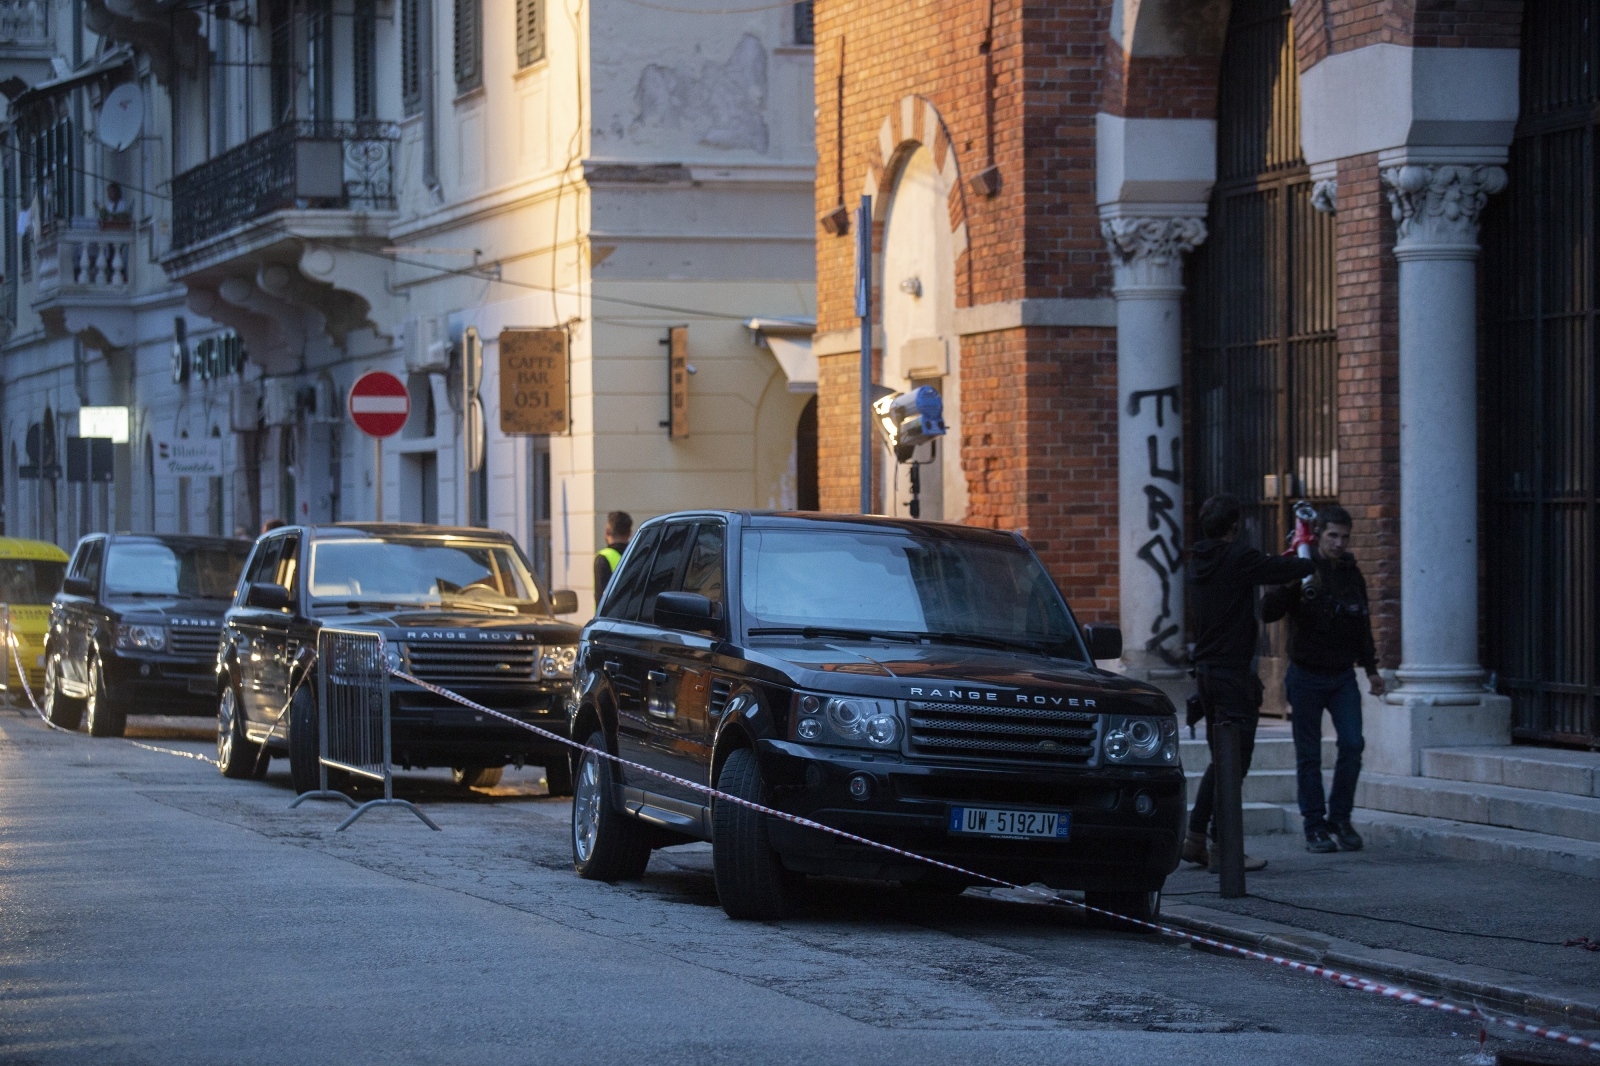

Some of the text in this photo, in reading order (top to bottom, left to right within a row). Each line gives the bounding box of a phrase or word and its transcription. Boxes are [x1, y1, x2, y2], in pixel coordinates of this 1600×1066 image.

[516, 371, 549, 385] BAR
[514, 390, 550, 408] 051
[170, 618, 217, 627] RANGE
[407, 631, 536, 641] RANGE ROVER
[910, 686, 1097, 707] RANGE ROVER
